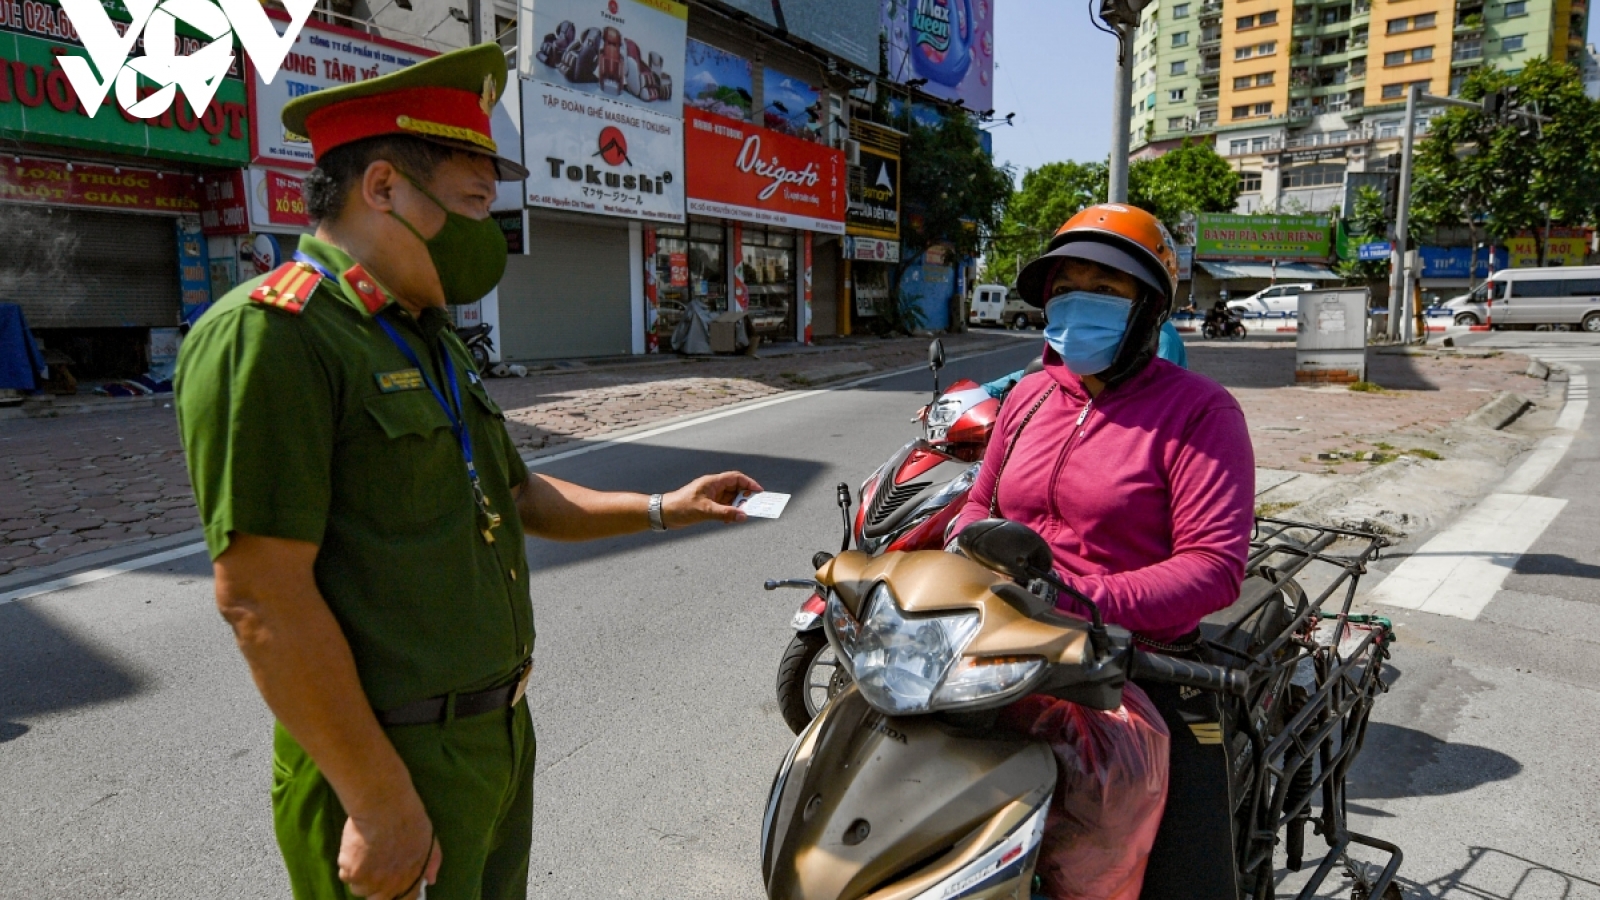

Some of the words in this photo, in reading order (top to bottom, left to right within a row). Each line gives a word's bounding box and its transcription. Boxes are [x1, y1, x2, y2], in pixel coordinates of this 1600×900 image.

[917, 0, 950, 20] Max
[331, 41, 341, 52] TY
[323, 57, 357, 84] TÂM
[542, 94, 560, 109] TẬP
[561, 98, 585, 115] ĐOÀN
[587, 102, 604, 119] GHẾ
[604, 110, 640, 128] MASSAGE
[642, 120, 671, 136] TOKUSHI
[545, 156, 664, 195] Tokushi
[735, 134, 820, 200] Origato
[76, 173, 151, 189] THUỐC
[84, 190, 138, 205] GIÁN
[275, 190, 290, 213] XỔ
[291, 195, 305, 214] SỐ
[1203, 225, 1237, 241] BÁNH
